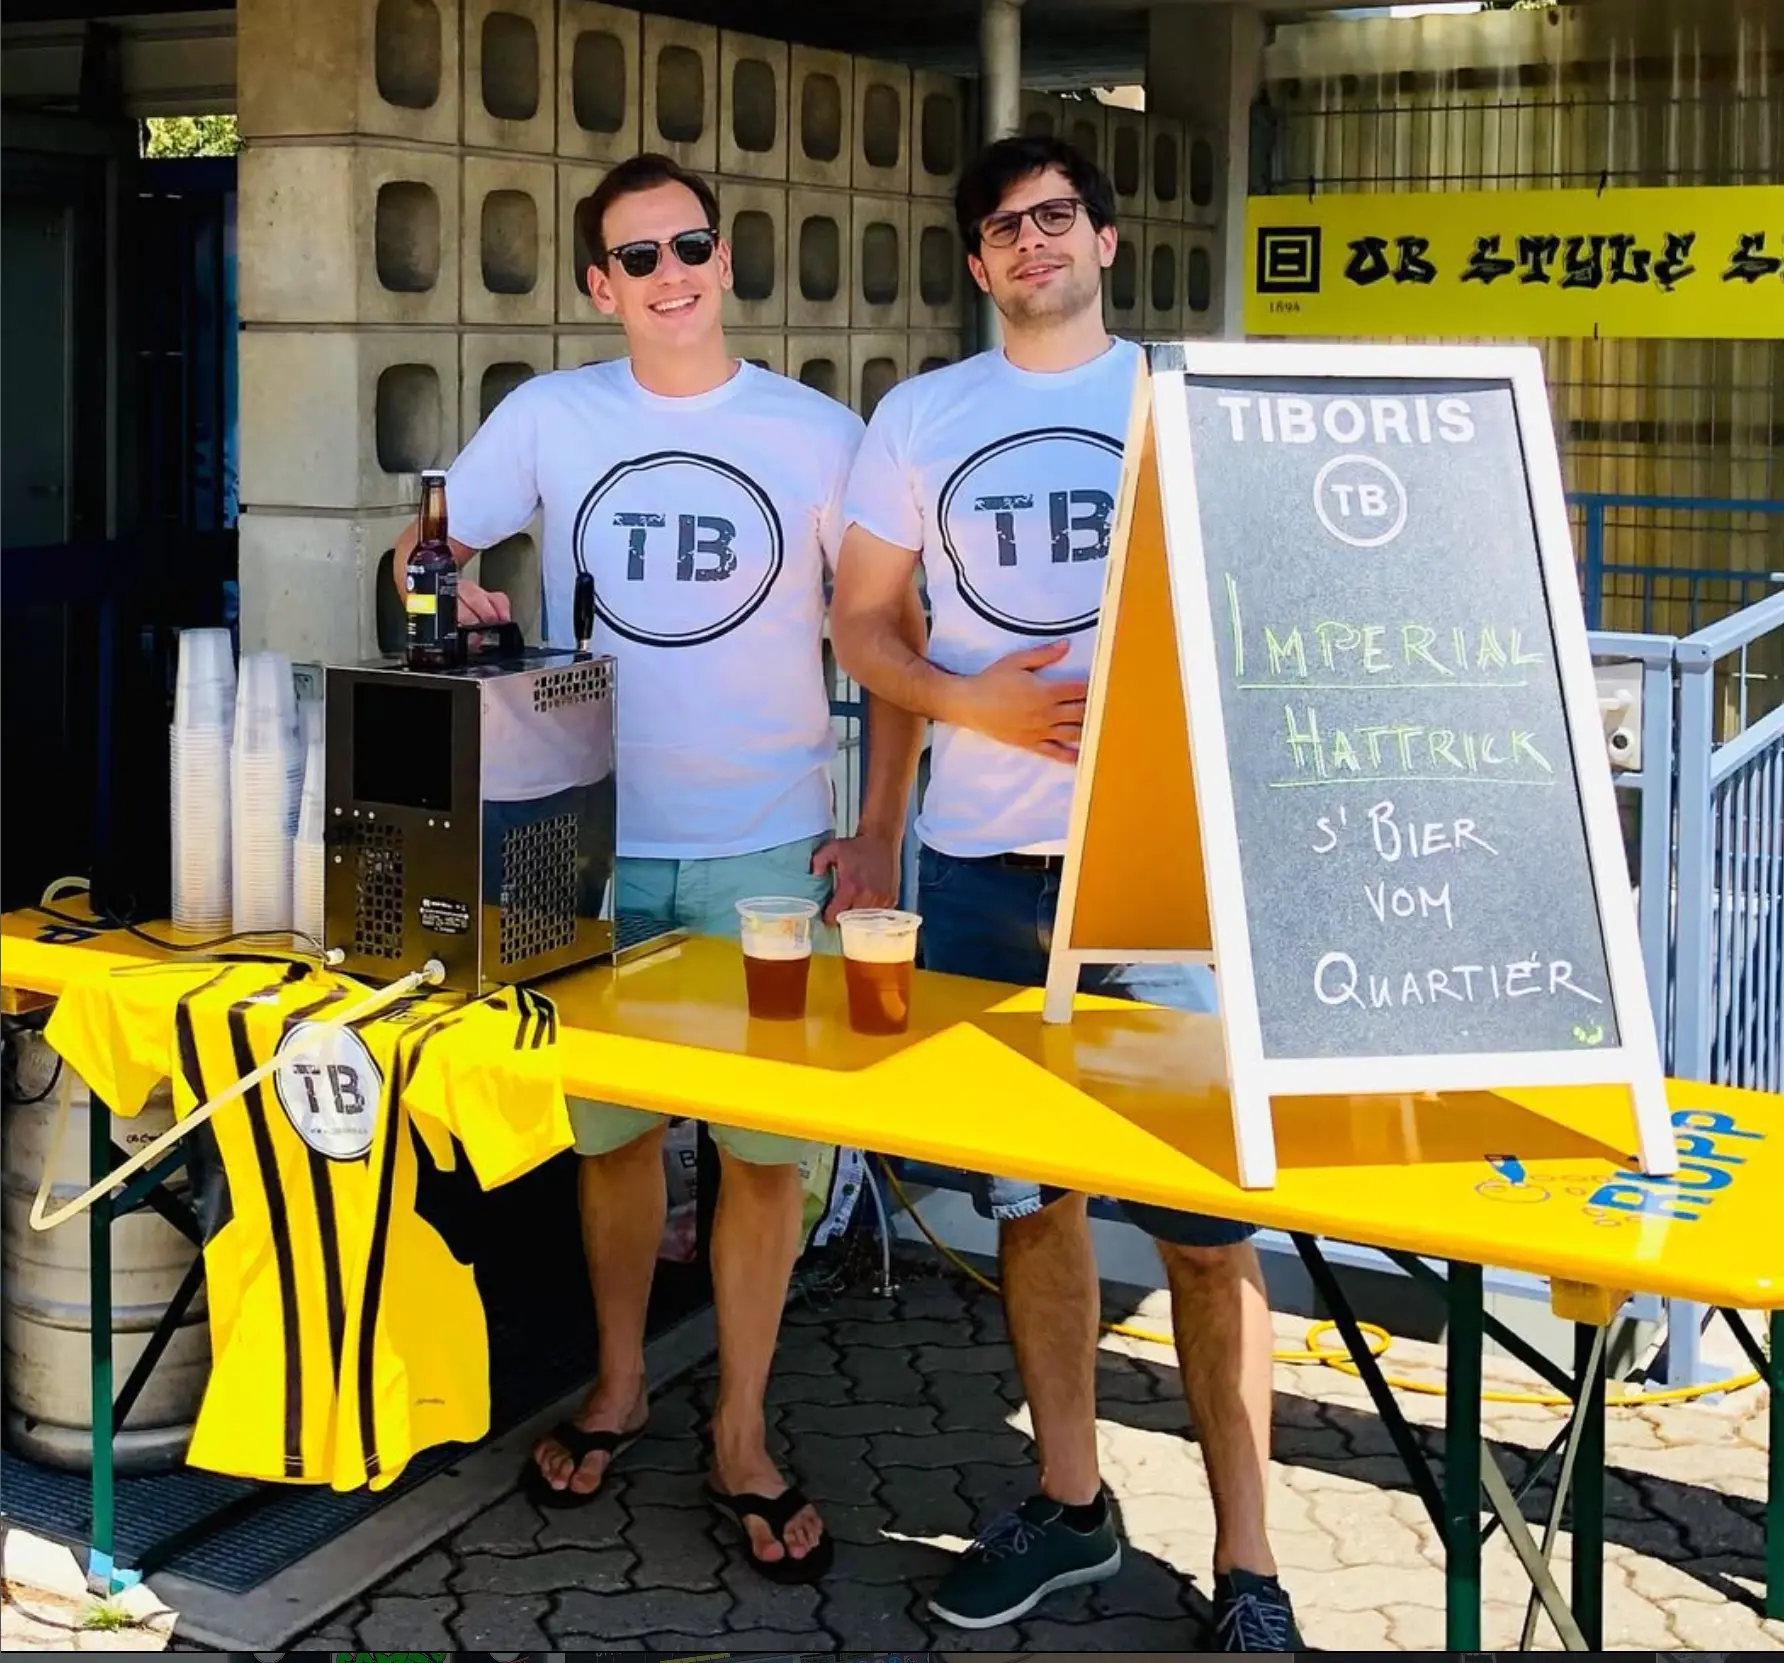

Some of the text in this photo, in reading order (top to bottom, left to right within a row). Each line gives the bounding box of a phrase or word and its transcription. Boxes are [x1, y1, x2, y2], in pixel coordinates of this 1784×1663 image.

[1459, 231, 1696, 293] STYLE
[1218, 396, 1476, 445] TIBORIS
[974, 488, 1115, 567] TB
[1330, 484, 1390, 518] TB
[612, 511, 738, 582] TB
[1225, 571, 1545, 678] IMPERIAL
[1284, 703, 1555, 779] HATTRICK
[1368, 800, 1499, 862] BIER
[292, 1063, 367, 1116] TB
